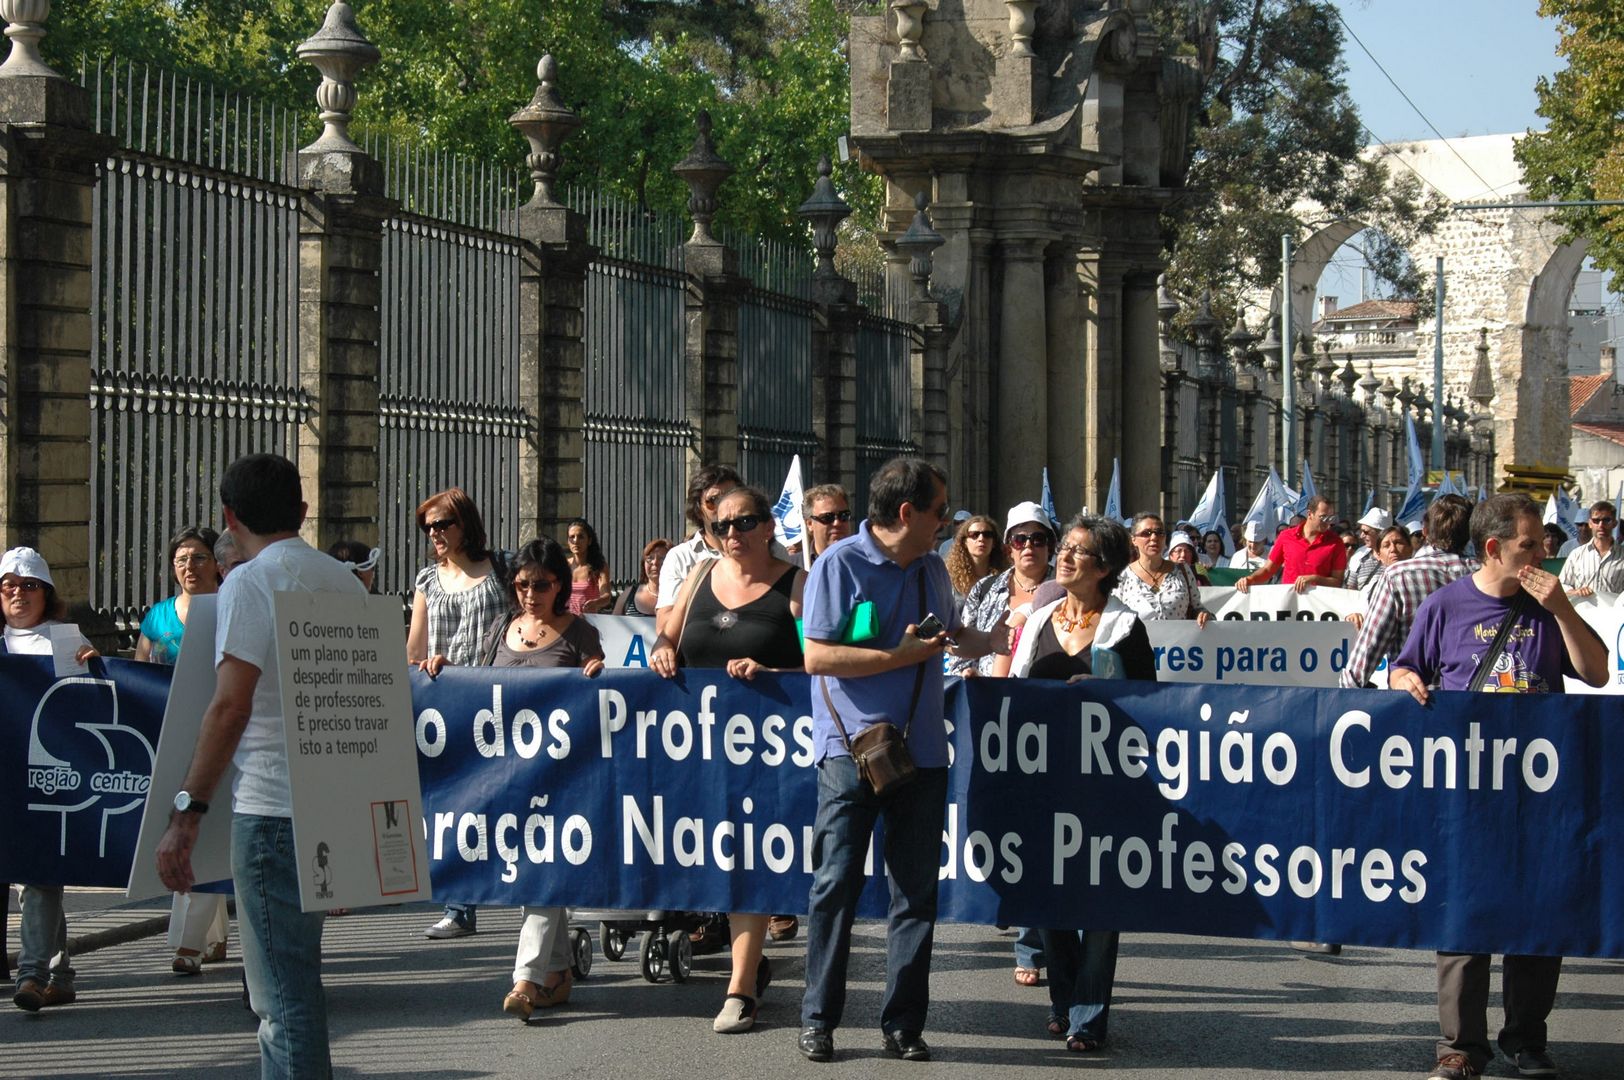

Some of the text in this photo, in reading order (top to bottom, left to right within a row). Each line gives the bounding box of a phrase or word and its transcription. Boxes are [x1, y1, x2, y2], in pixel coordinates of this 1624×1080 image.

[289, 621, 379, 639] O Governo tem
[291, 645, 377, 666] um plano para
[1216, 645, 1287, 680] para
[1300, 647, 1318, 673] o
[293, 668, 393, 688] despedir milhares
[295, 691, 385, 712] de professores.
[297, 712, 388, 736] É preciso travar
[299, 738, 378, 758] isto a tempo!
[473, 684, 571, 760] dos
[980, 697, 1048, 774] da
[1080, 701, 1297, 800] Região
[1330, 709, 1559, 793] Centro
[28, 768, 151, 794] região centro
[423, 794, 592, 883] ração
[1052, 812, 1428, 904] Professores
